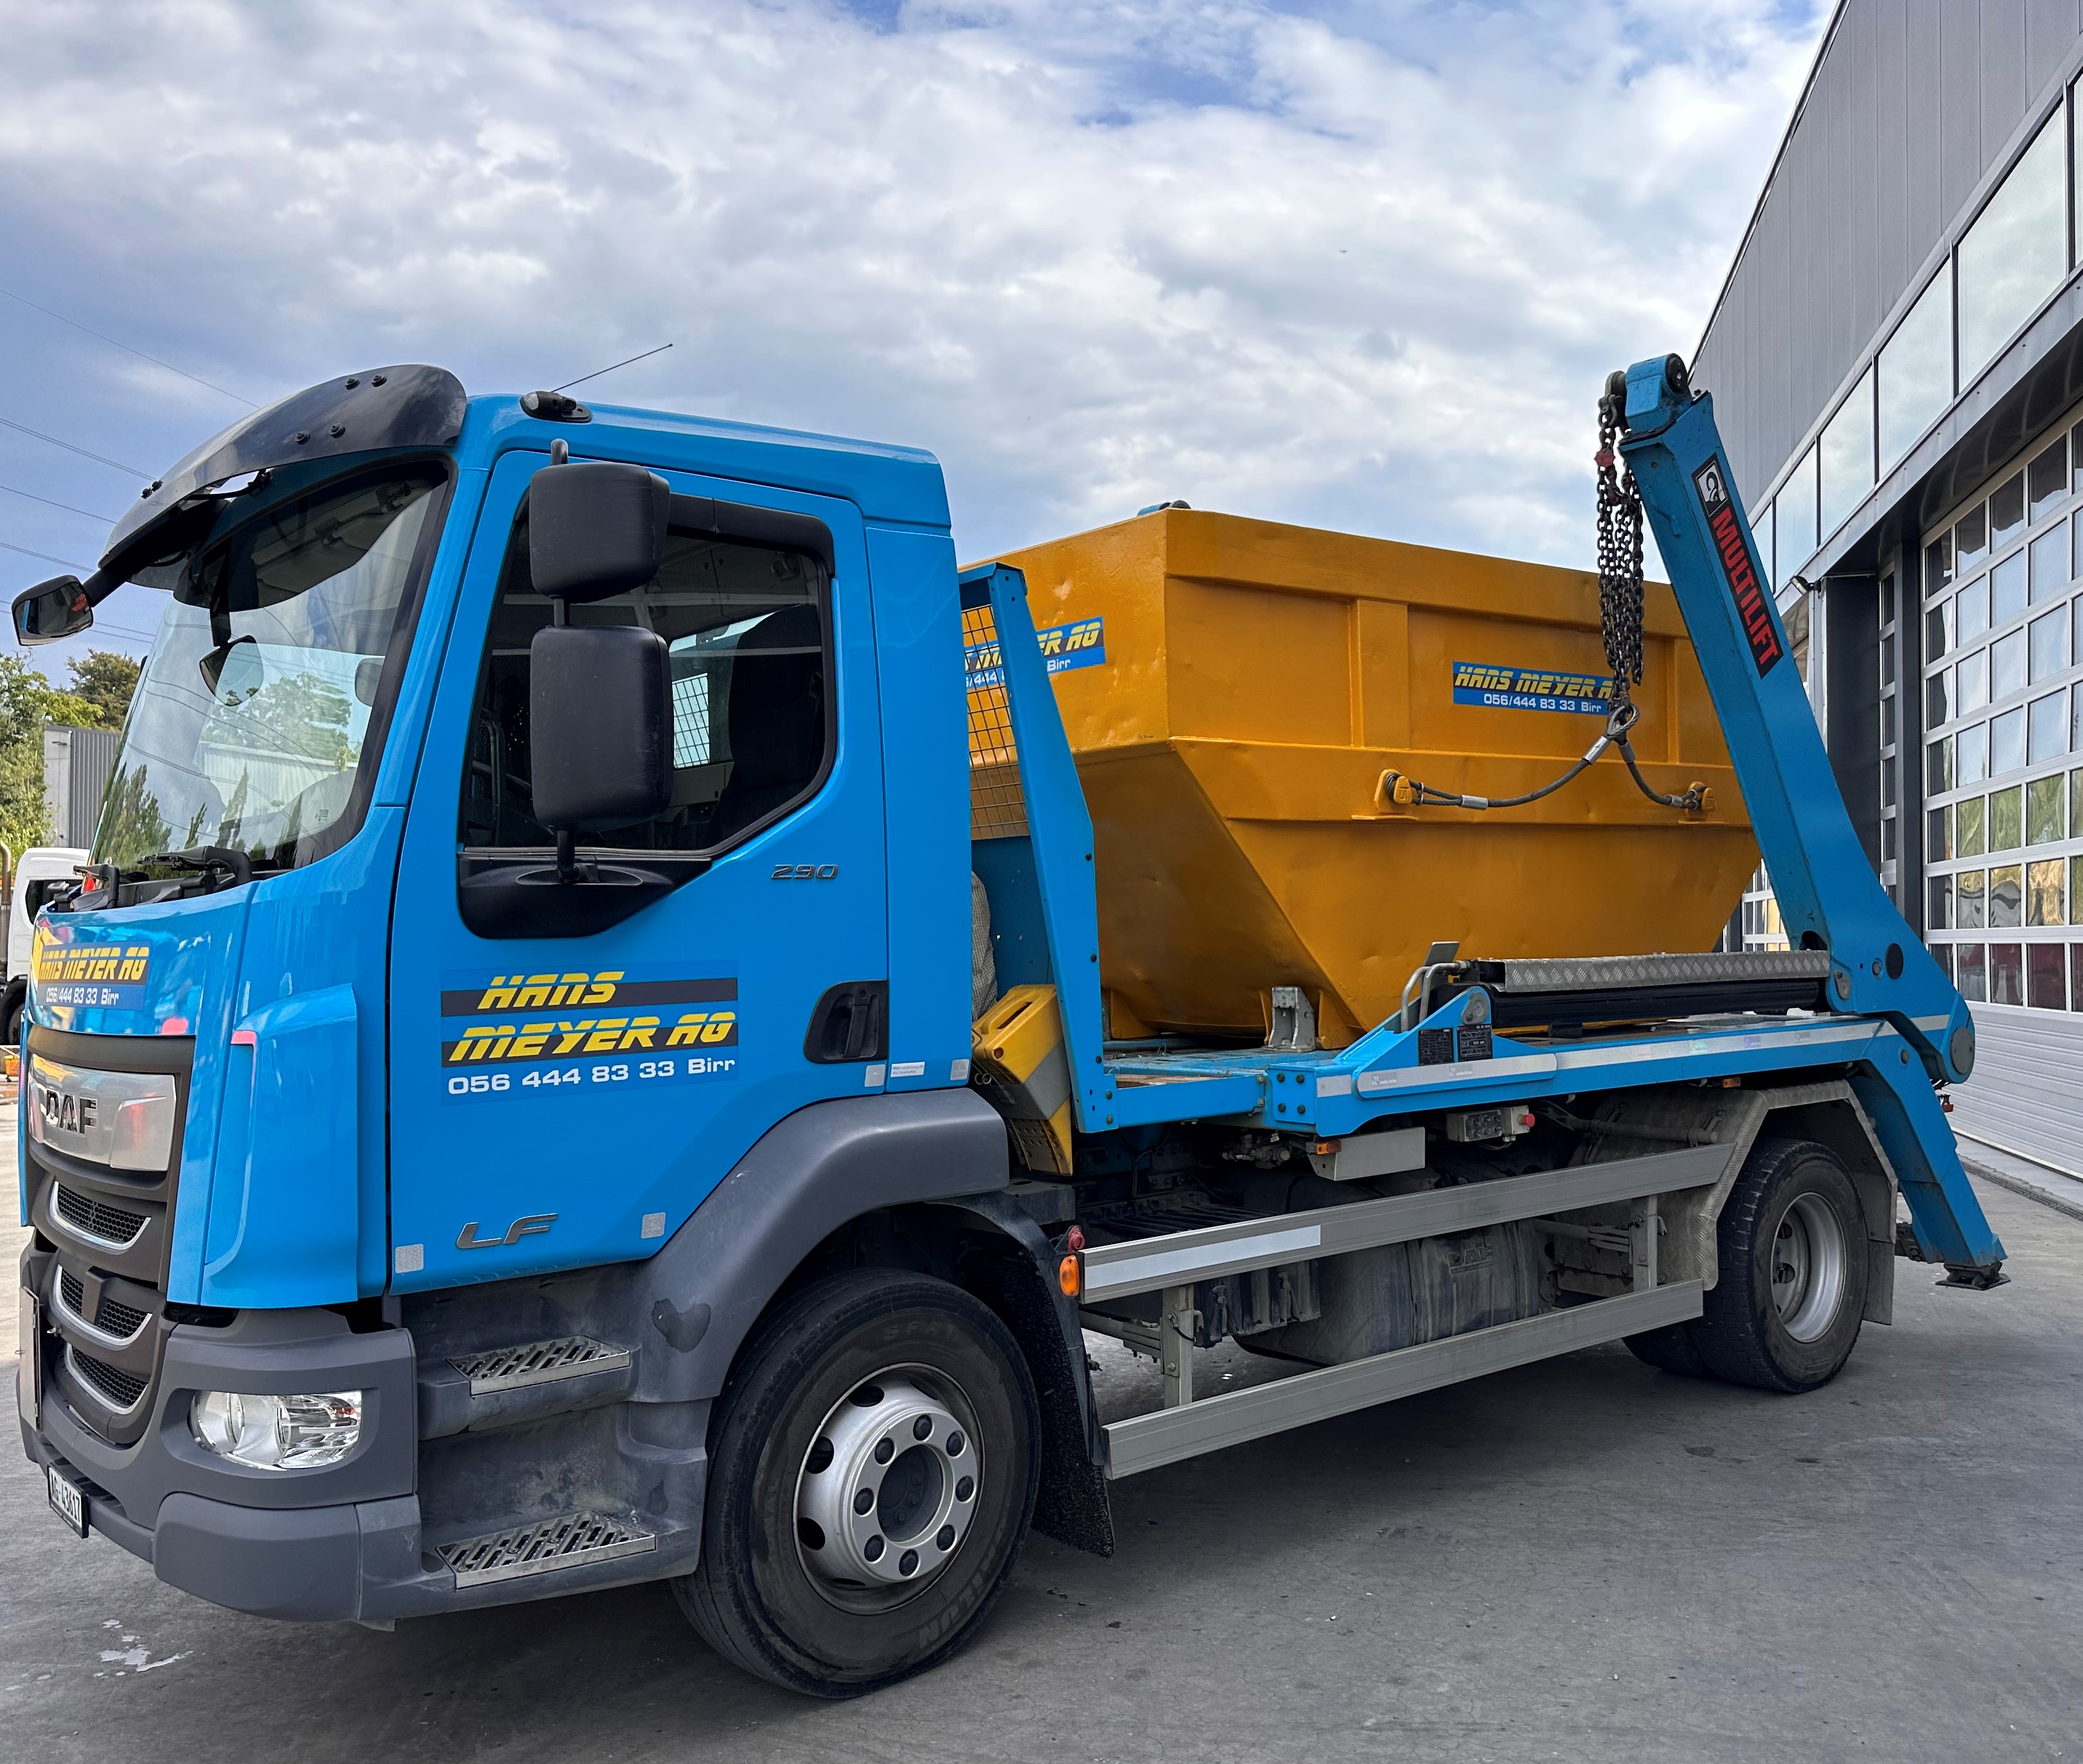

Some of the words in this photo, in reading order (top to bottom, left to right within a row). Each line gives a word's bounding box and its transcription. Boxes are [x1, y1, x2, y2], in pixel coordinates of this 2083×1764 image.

[1712, 507, 1778, 664] MULTILIFT
[1065, 622, 1101, 651] AG
[1046, 658, 1071, 673] Birr
[1455, 666, 1513, 691] HANS
[1515, 673, 1595, 698] MEYER
[1598, 679, 1613, 698] A
[1484, 694, 1536, 708] 056/444
[1540, 698, 1556, 710] 83
[1559, 700, 1575, 711] 33
[1581, 701, 1602, 712] Birr
[771, 864, 838, 879] 290
[63, 948, 121, 980] MEYER
[118, 947, 149, 980] AG
[73, 987, 84, 1004] 83
[85, 987, 97, 1005] 33
[101, 988, 119, 1005] Birr
[477, 971, 625, 1010] HANS
[448, 1016, 660, 1061] MEYER
[666, 1011, 736, 1046] AG
[448, 1073, 511, 1095] 056
[522, 1068, 581, 1087] 444
[592, 1064, 629, 1082] 83
[639, 1060, 675, 1078] 33
[687, 1057, 736, 1075] Birr
[46, 1088, 97, 1135] DAF
[456, 1213, 558, 1249] LF
[1447, 1246, 1494, 1268] DAF
